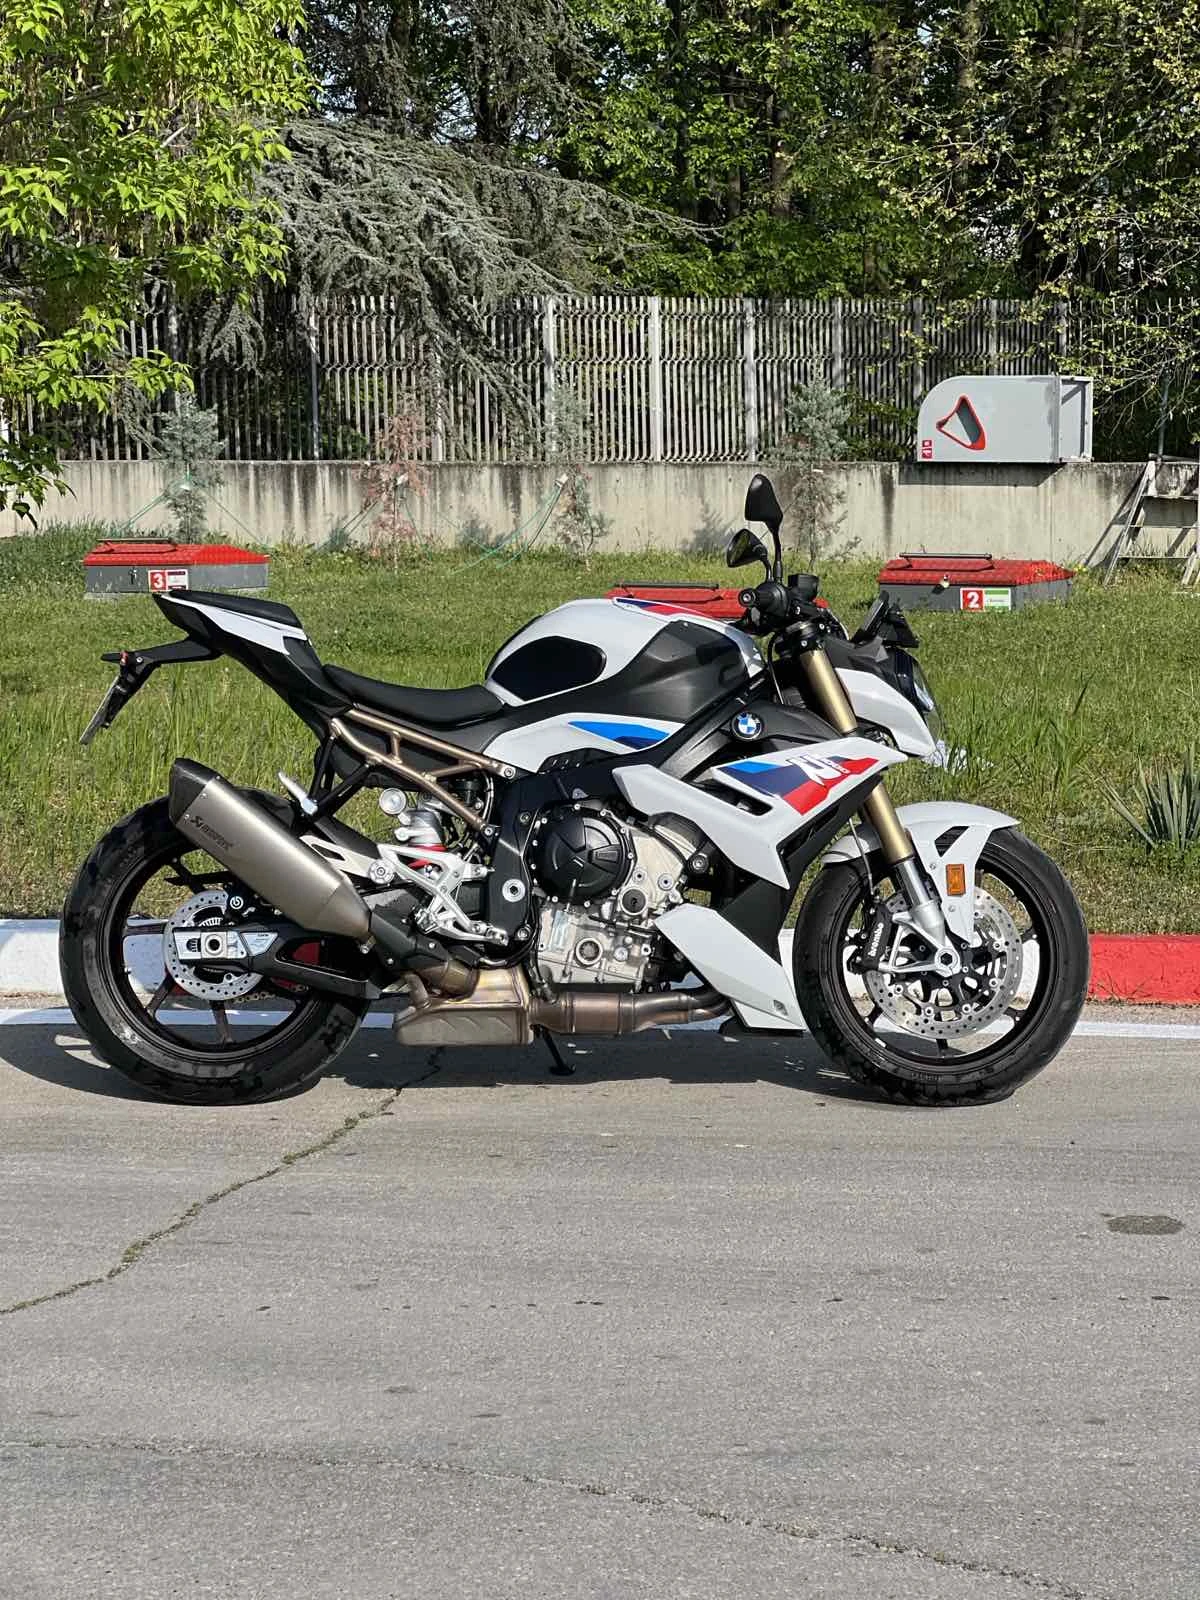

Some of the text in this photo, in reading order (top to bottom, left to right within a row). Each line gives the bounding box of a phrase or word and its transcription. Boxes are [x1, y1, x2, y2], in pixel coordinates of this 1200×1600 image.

[153, 573, 164, 589] 3
[967, 591, 980, 608] 2
[867, 922, 884, 957] brembo
